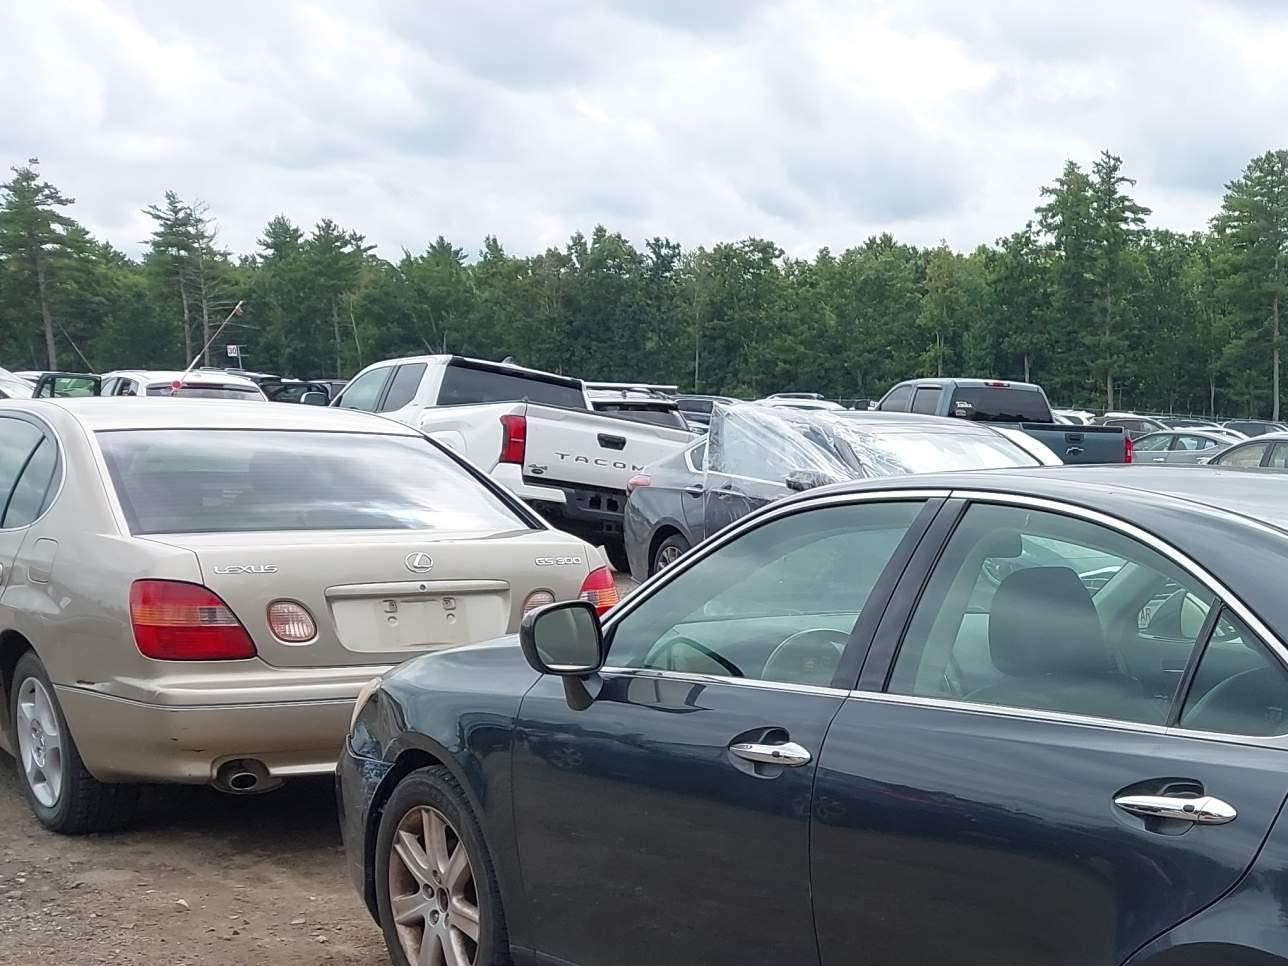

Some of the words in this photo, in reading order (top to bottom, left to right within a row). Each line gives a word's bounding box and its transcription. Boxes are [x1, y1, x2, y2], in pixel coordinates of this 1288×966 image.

[554, 452, 645, 472] TACOM
[535, 557, 554, 566] GS
[556, 556, 582, 565] 300
[213, 564, 278, 575] LEXUS
